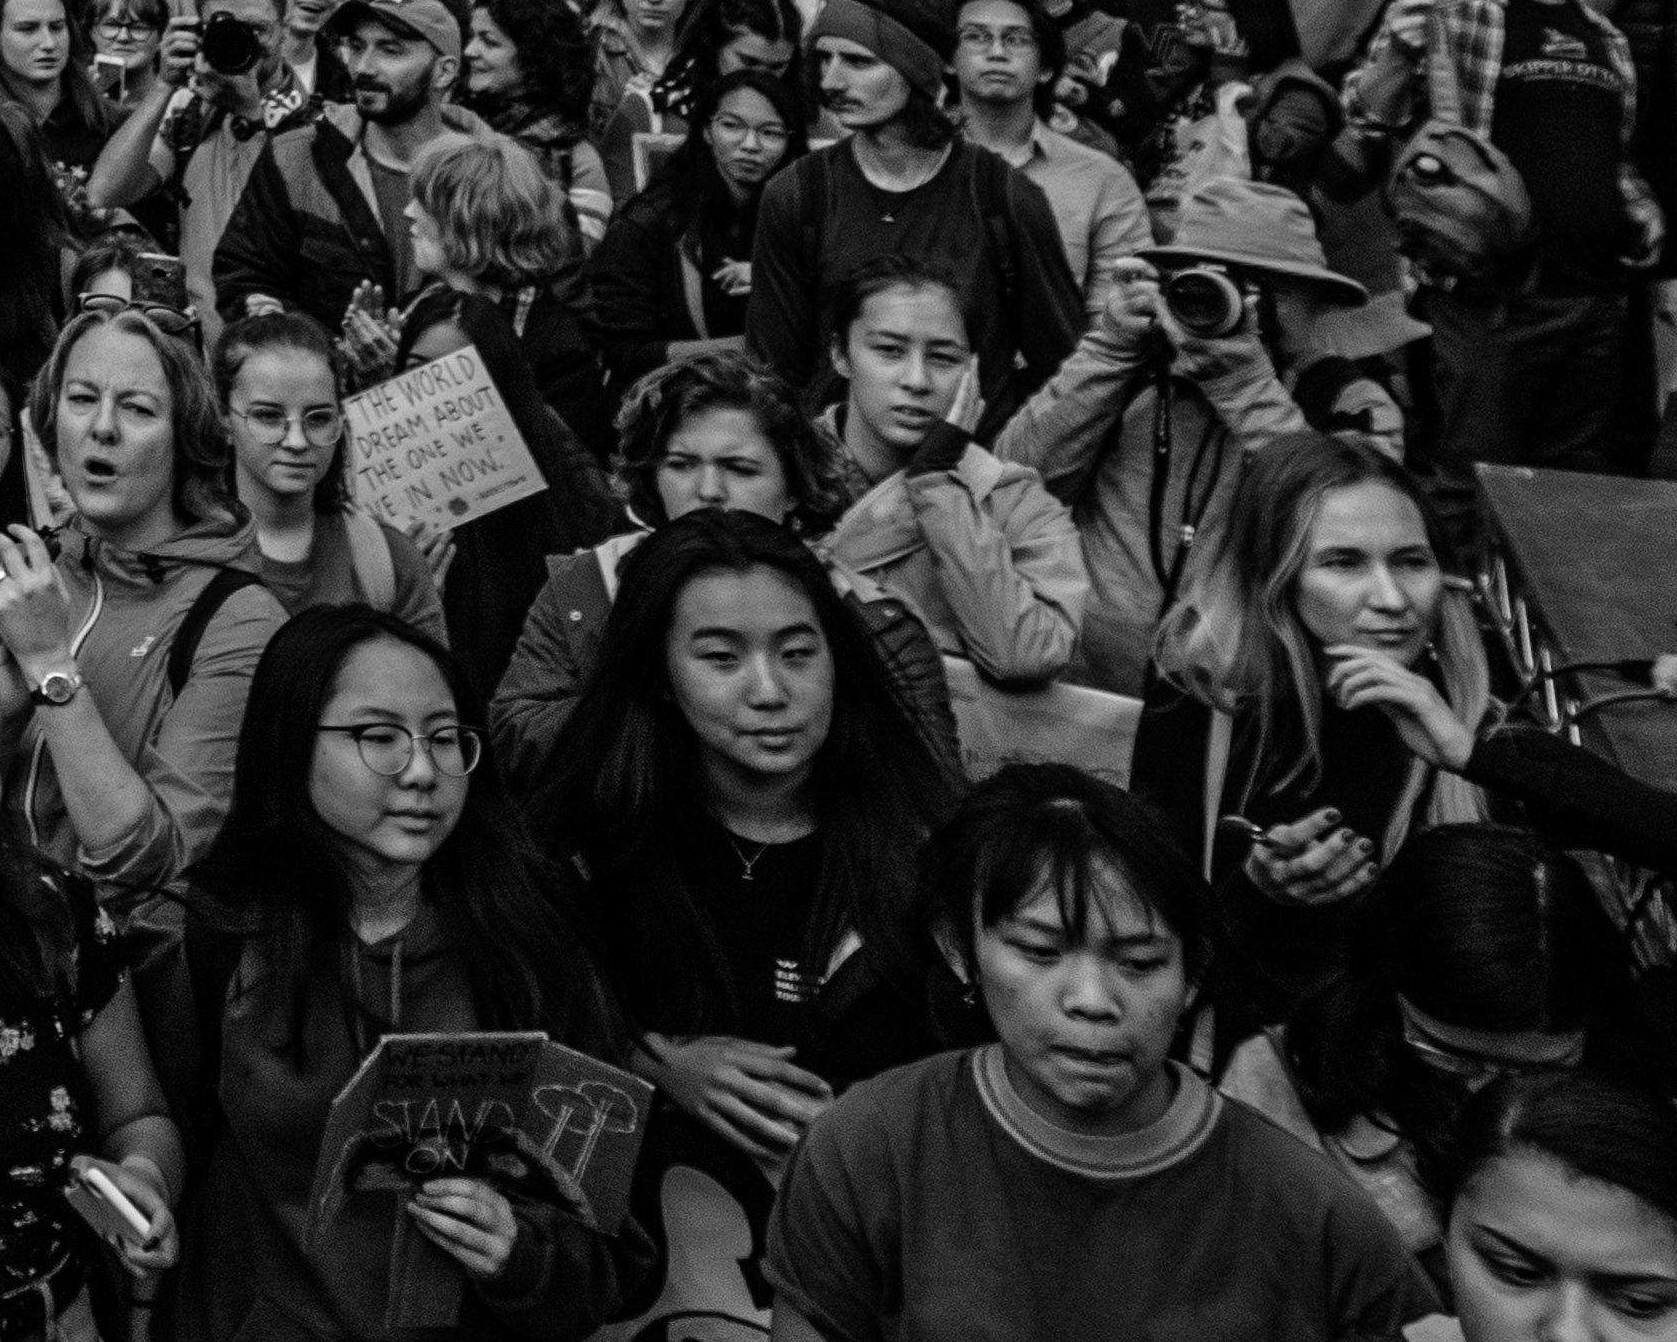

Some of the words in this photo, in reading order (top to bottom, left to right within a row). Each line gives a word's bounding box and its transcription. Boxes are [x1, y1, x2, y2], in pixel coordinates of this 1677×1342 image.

[350, 383, 398, 426] THE
[396, 354, 476, 408] WORLD
[356, 415, 431, 459] DREAM
[433, 385, 496, 428] ABOUT
[358, 457, 402, 492] THE
[407, 439, 448, 470] ONE
[449, 422, 486, 449] WE
[404, 479, 434, 510] IN
[439, 448, 505, 493] NOW.
[371, 1098, 516, 1149] STAND
